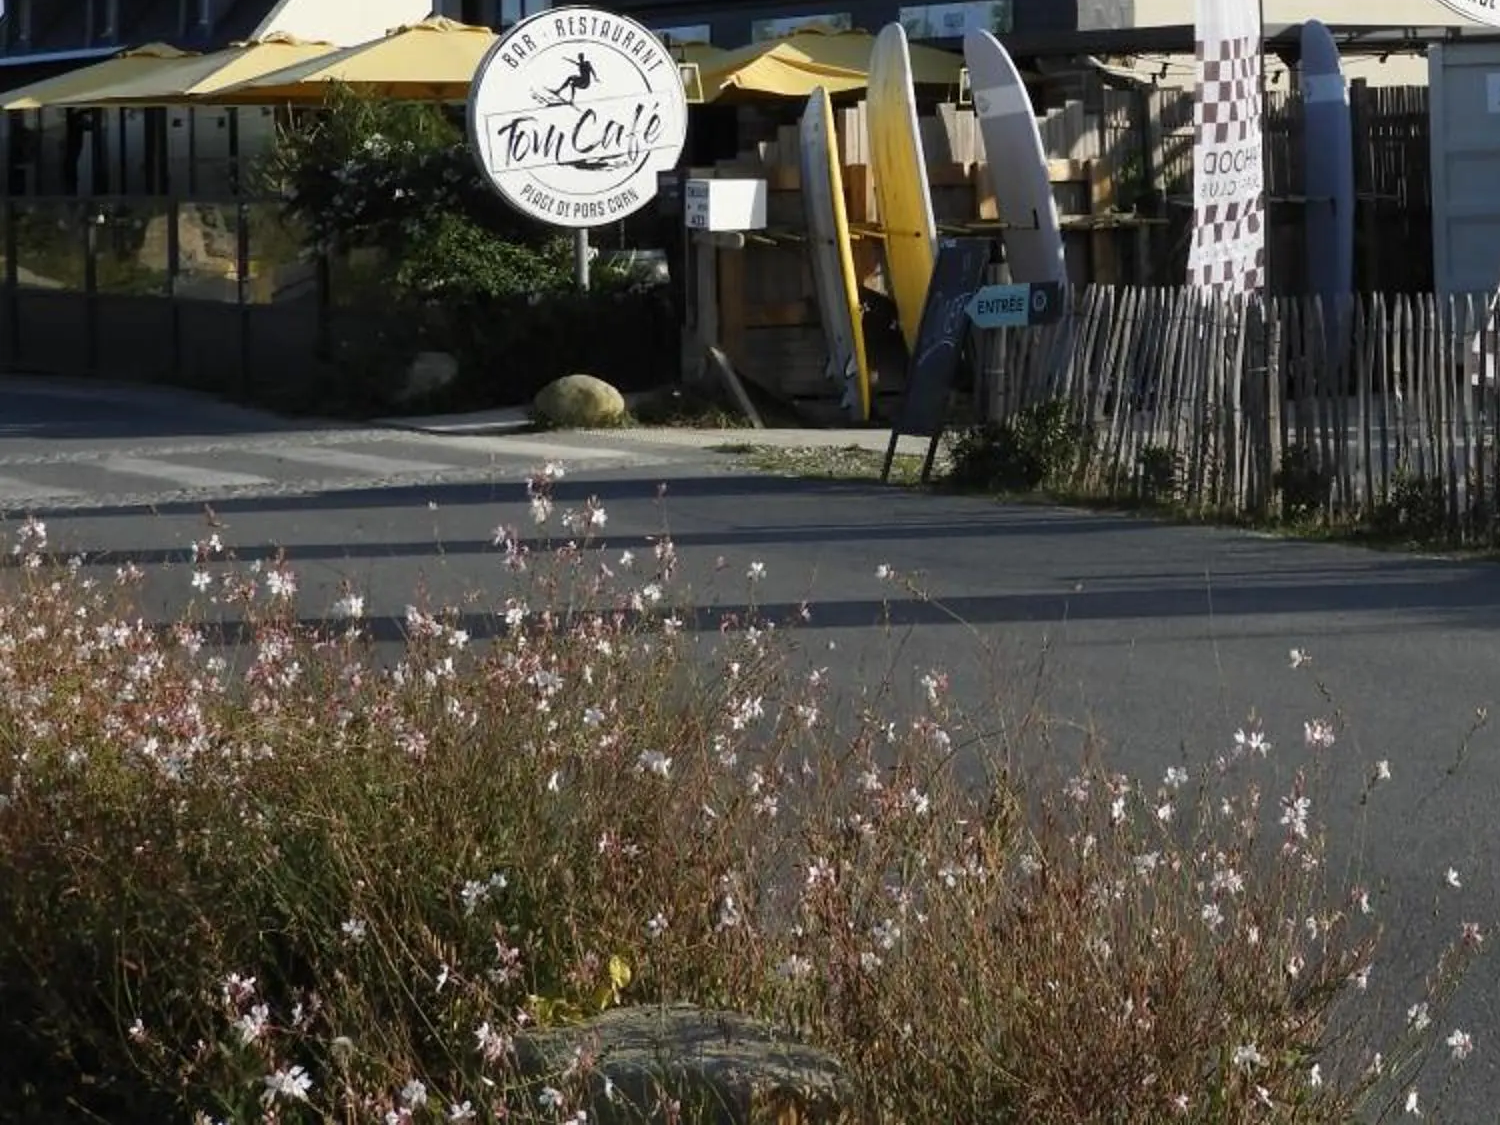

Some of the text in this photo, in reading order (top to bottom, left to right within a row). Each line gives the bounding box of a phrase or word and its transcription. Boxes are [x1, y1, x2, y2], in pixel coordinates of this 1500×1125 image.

[501, 16, 663, 72] BAR RESTAURANT
[498, 102, 661, 166] Tom Café
[520, 183, 555, 213] PLAGE
[573, 200, 605, 219] PORS
[977, 295, 1025, 315] ENTRÉE
